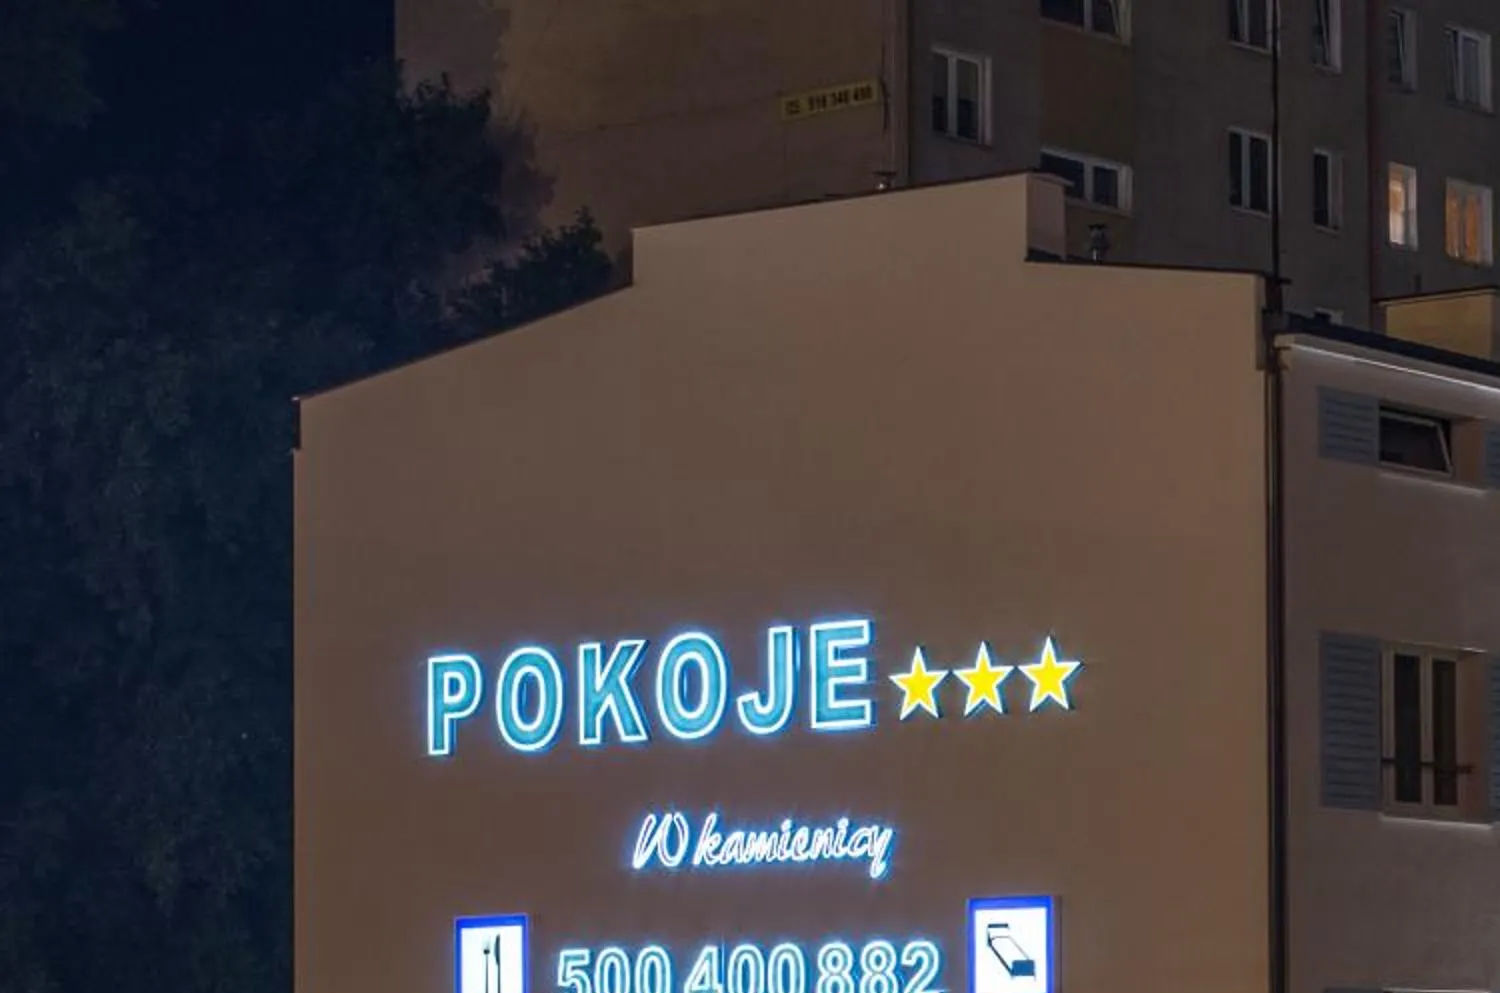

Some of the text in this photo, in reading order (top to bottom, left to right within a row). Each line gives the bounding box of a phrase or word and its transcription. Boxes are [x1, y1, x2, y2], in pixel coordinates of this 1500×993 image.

[426, 619, 874, 756] POKOJE
[632, 812, 893, 878] W kamienicy
